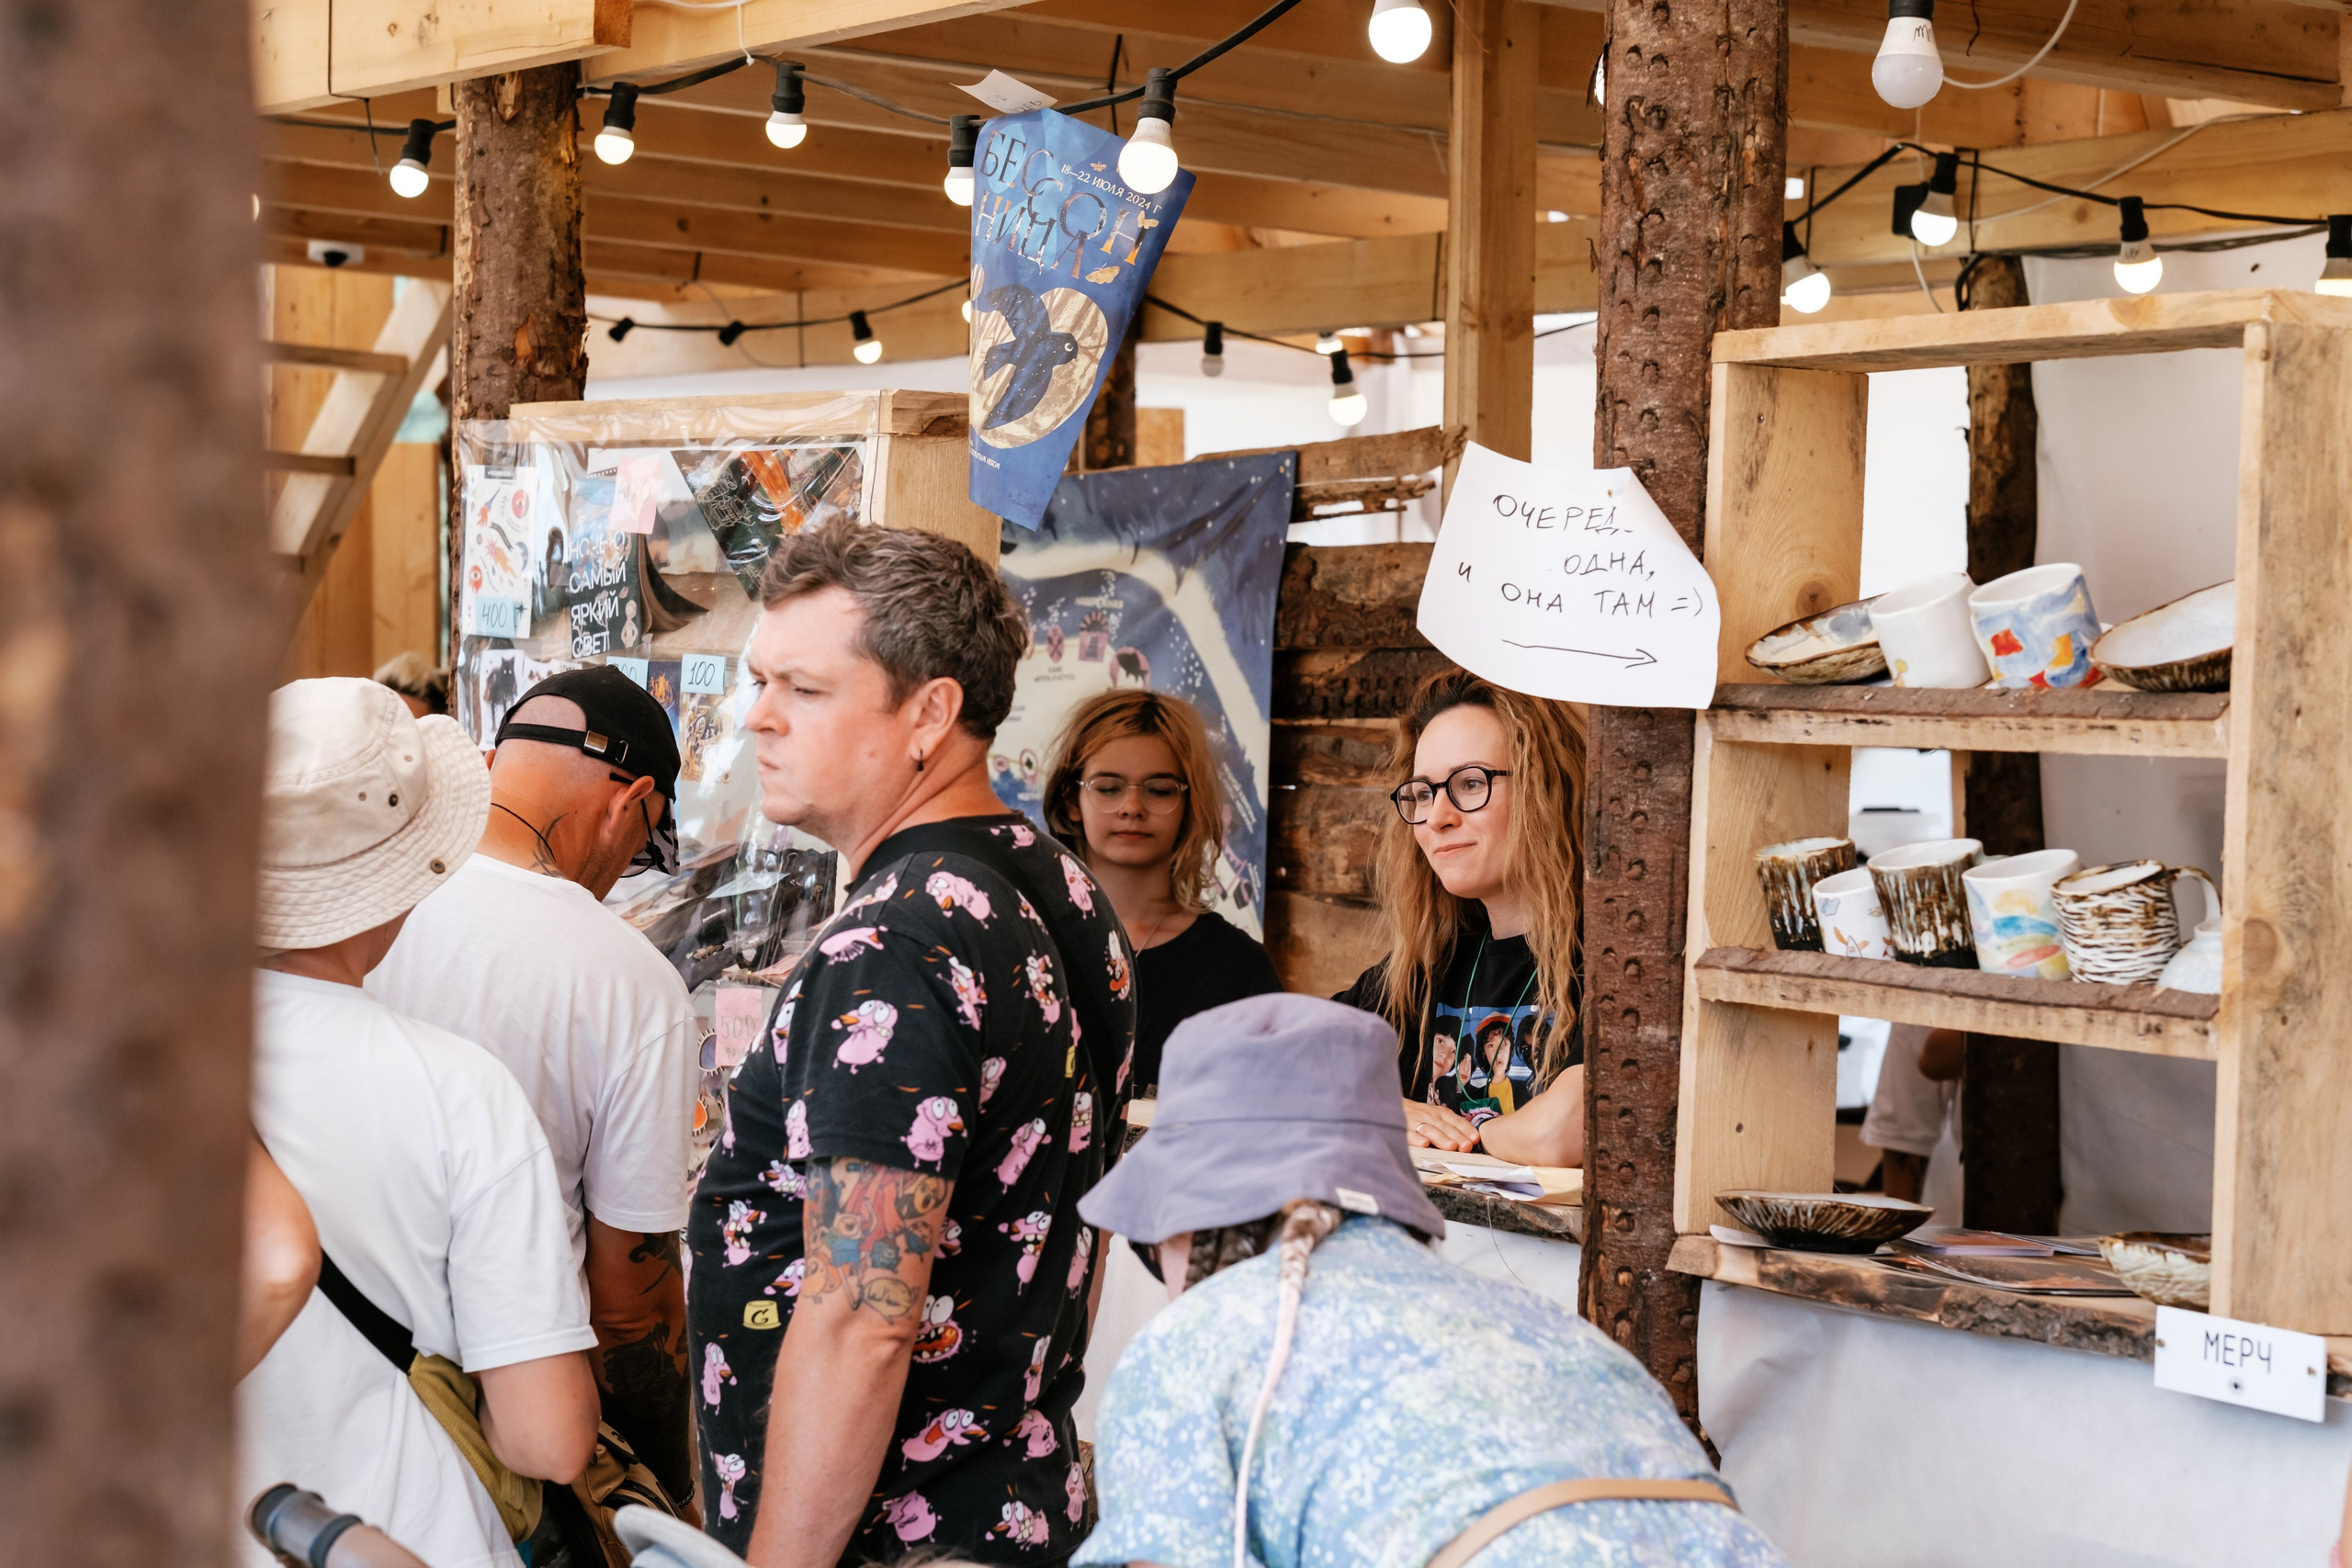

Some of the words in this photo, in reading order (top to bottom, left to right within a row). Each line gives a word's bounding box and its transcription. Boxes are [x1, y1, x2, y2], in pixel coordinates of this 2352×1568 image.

[978, 130, 1055, 197] БЕС
[1091, 176, 1125, 197] ИЮЛЯ
[1125, 191, 1152, 210] 2024
[1493, 494, 1634, 536] ОЧЕРЕД
[1564, 550, 1656, 581] ОДНА,
[481, 602, 508, 628] 400
[571, 590, 619, 626] ЯРКИЙ
[1501, 582, 1564, 614] ОНА
[1594, 590, 1656, 618] ТАМ
[571, 630, 610, 659] СВЕТ
[687, 660, 716, 687] 100
[720, 1013, 756, 1040] 500
[2203, 1330, 2273, 1374] МЕРЧ
